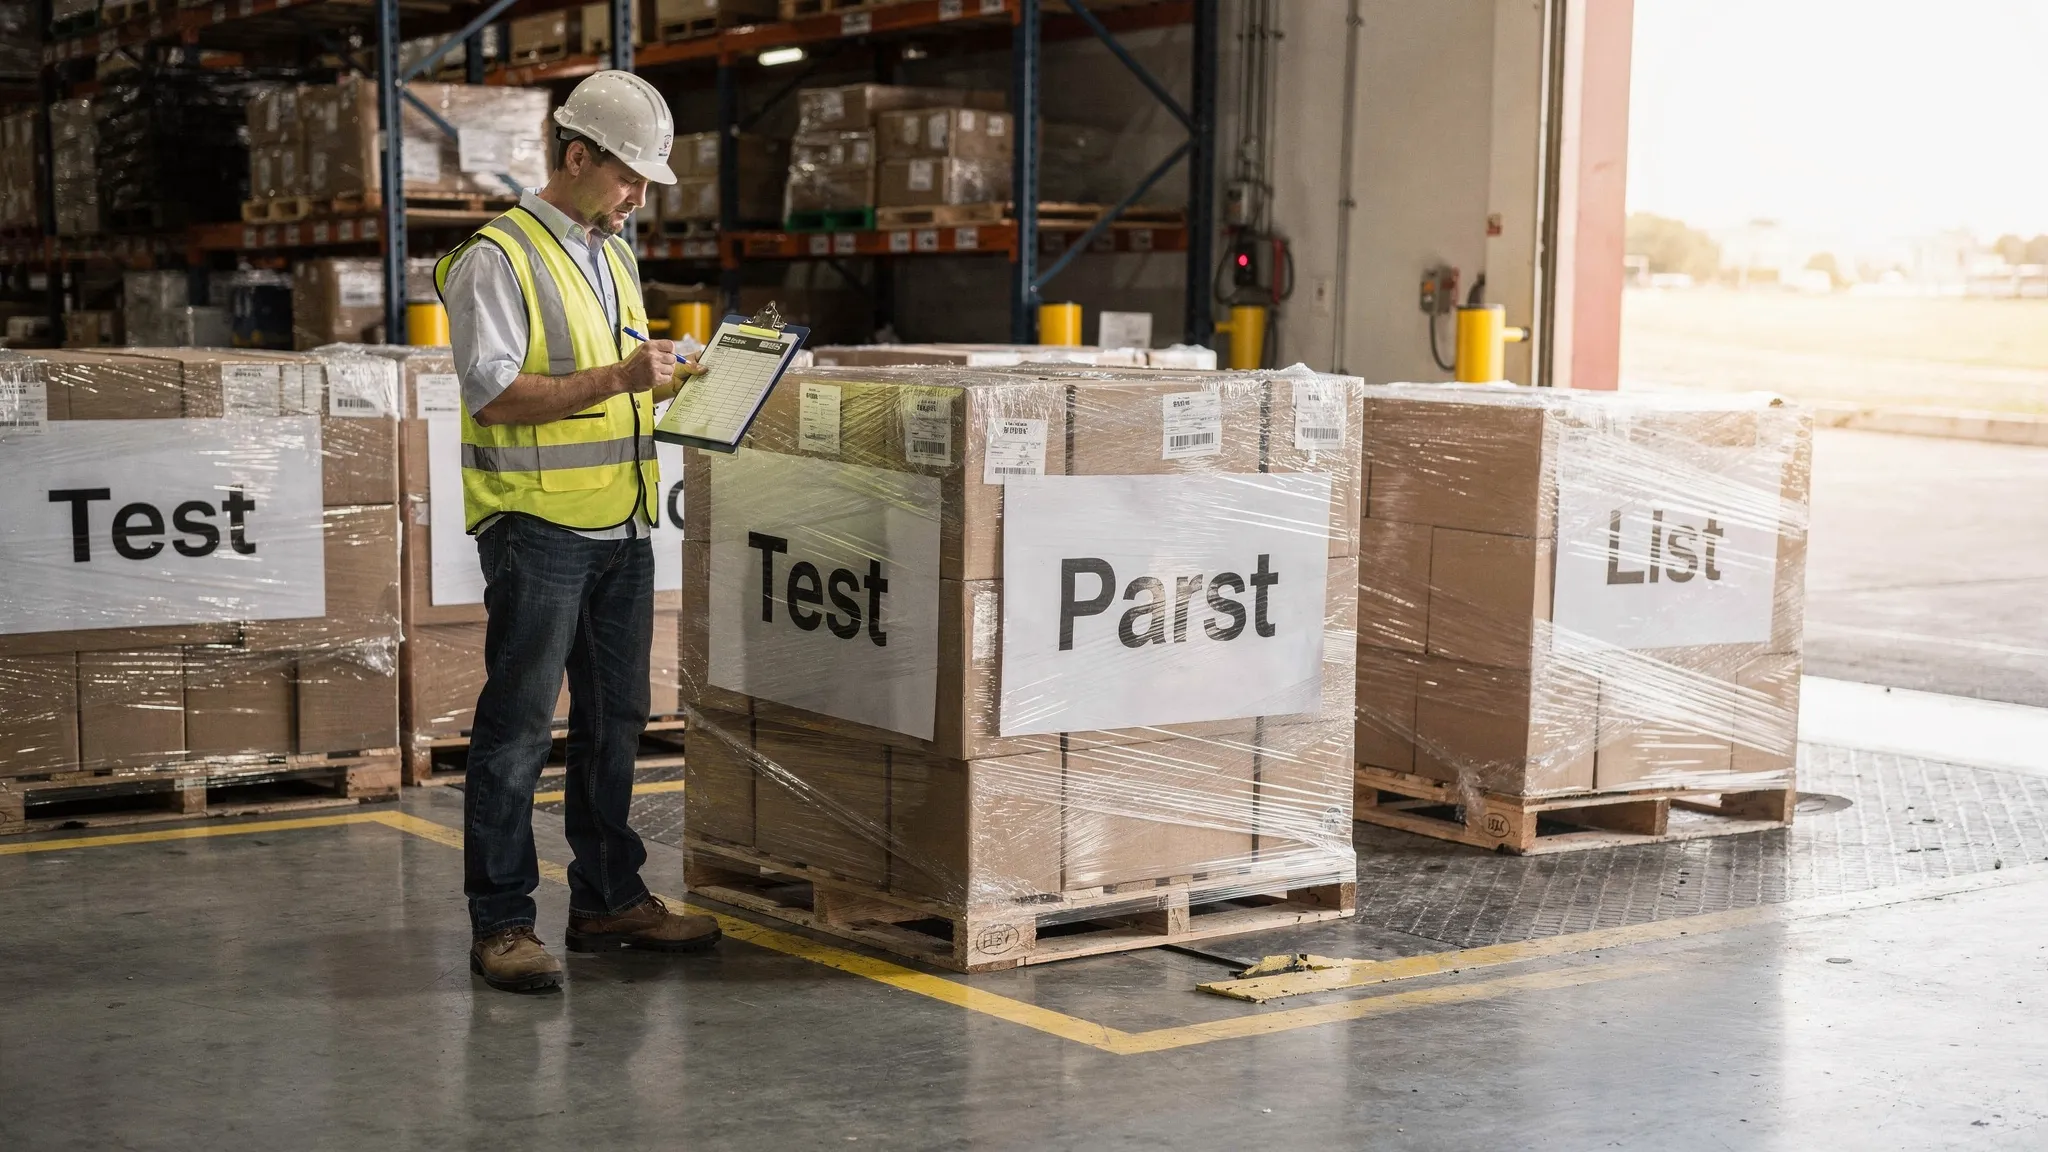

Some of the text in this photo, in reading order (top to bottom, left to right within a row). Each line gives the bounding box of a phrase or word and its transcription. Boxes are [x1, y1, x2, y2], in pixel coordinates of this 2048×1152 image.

[48, 485, 256, 562] Test
[748, 531, 889, 647] Test
[1058, 553, 1279, 651] Parst
